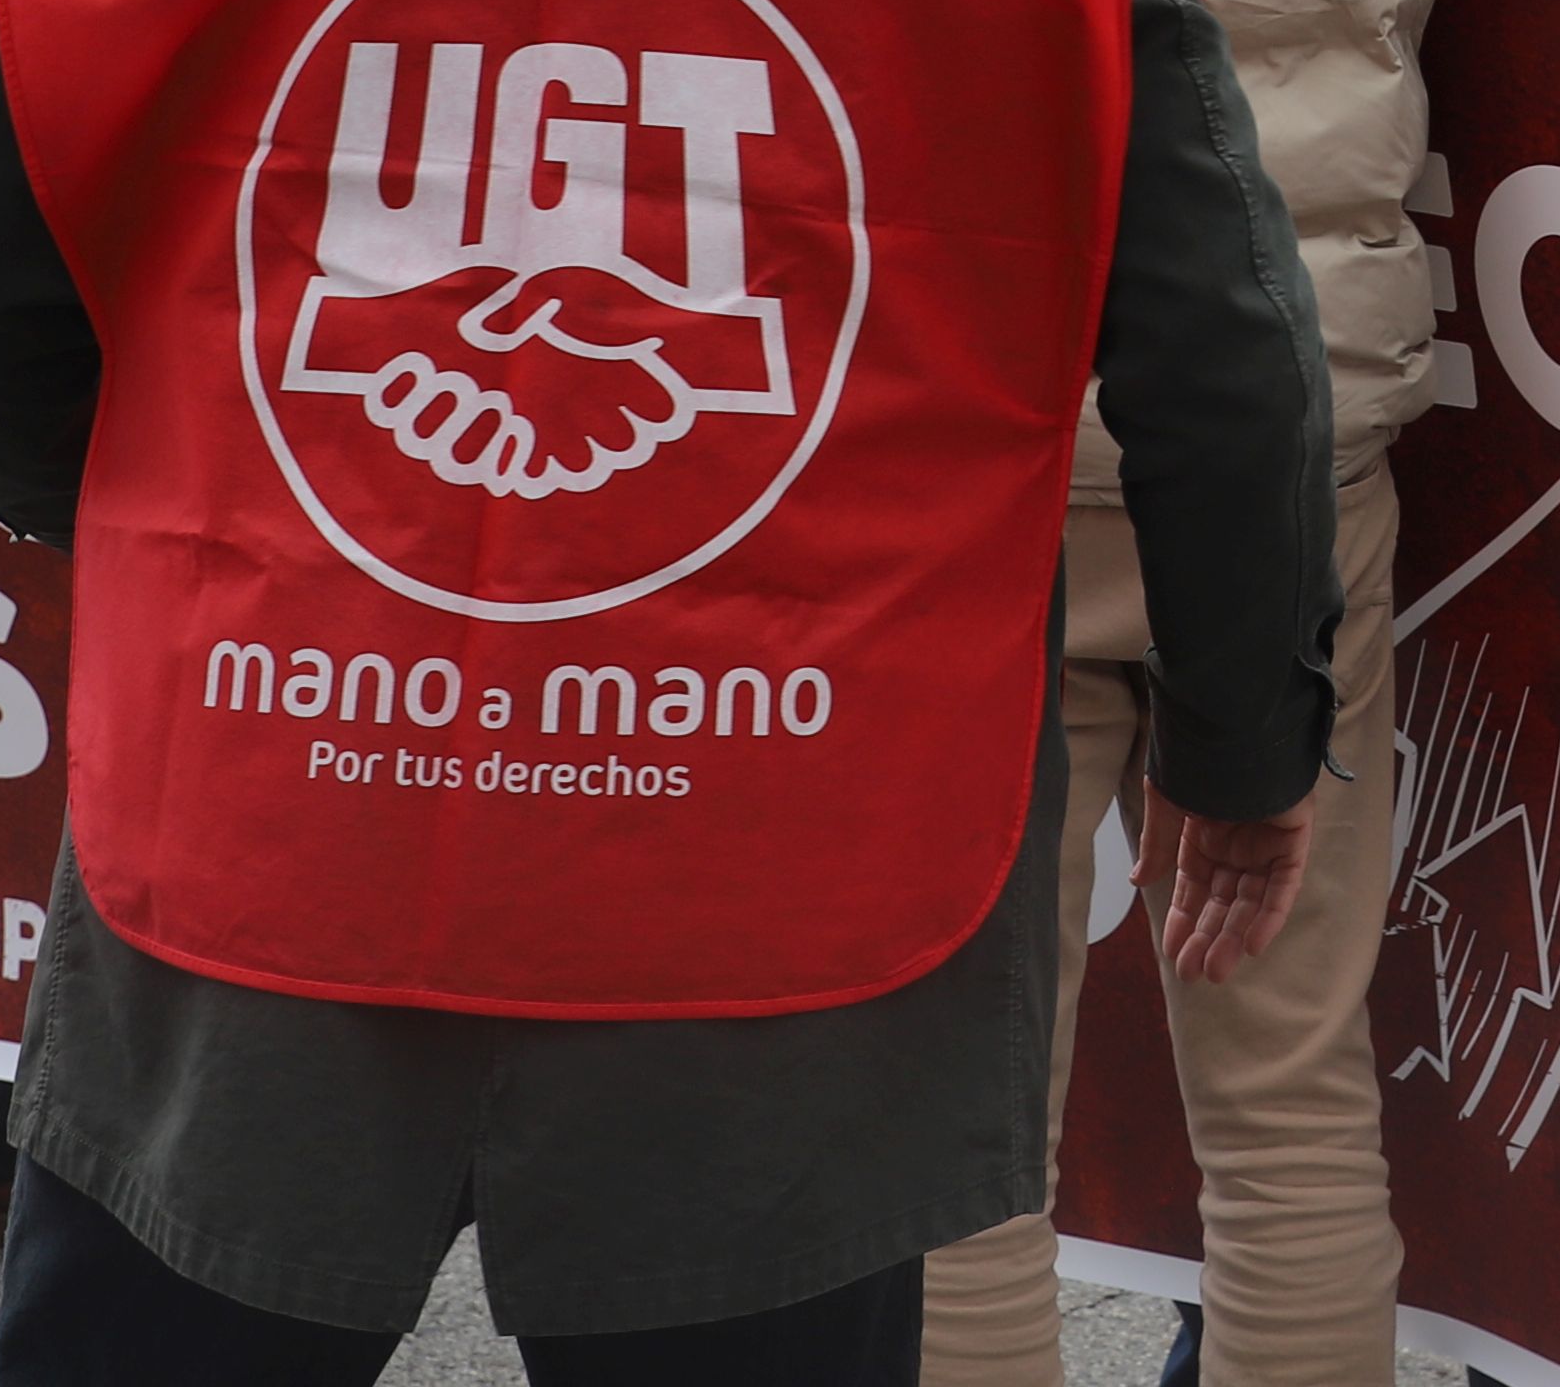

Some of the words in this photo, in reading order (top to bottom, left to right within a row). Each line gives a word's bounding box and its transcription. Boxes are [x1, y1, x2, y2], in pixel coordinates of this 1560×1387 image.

[315, 40, 775, 315] UGT
[203, 639, 461, 727] mano
[477, 682, 511, 730] a
[539, 664, 833, 738] mano
[307, 741, 383, 785] Por
[393, 747, 464, 789] tus
[474, 750, 691, 798] derechos
